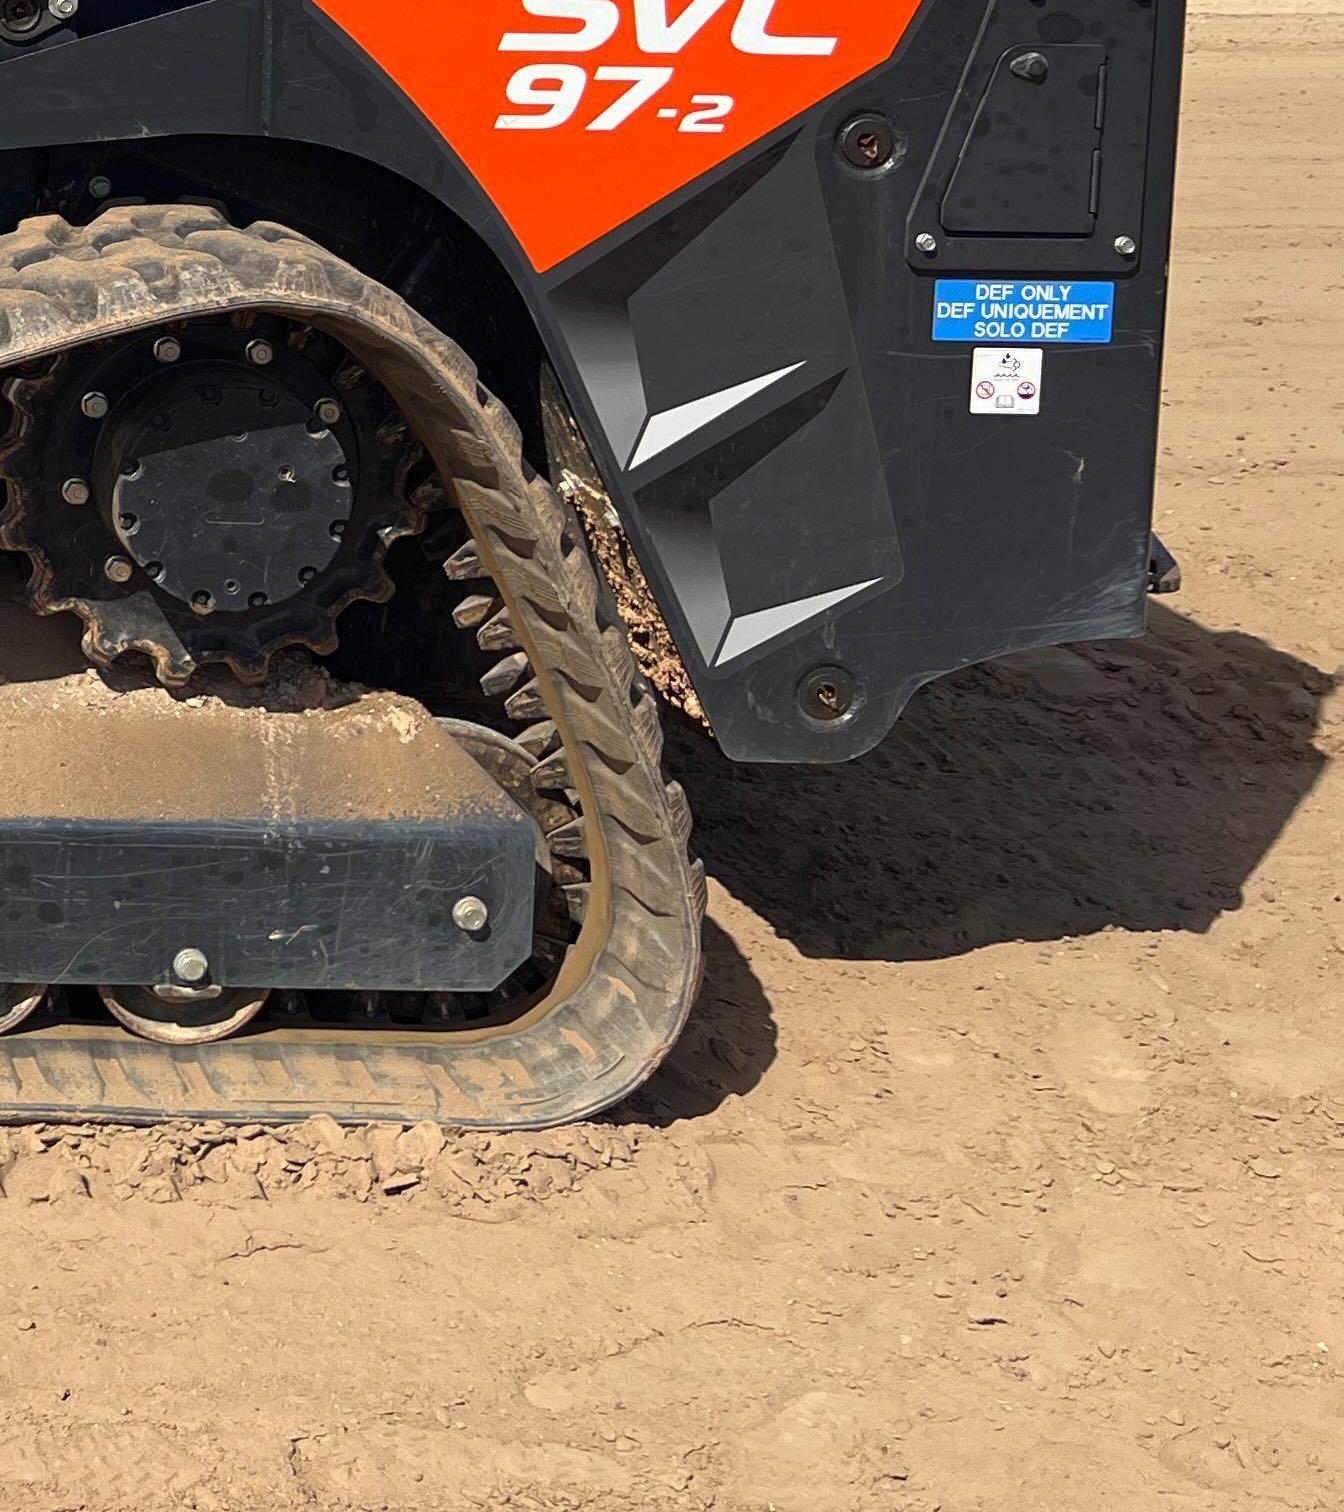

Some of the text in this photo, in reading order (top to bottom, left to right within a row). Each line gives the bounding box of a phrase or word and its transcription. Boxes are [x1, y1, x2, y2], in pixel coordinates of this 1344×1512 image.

[494, 63, 735, 133] 97-2
[975, 284, 1072, 302] DEF ONLY
[936, 302, 1109, 320] DEF UNIQUEMENT
[973, 321, 1025, 338] SOLO
[1031, 322, 1070, 339] DEF
